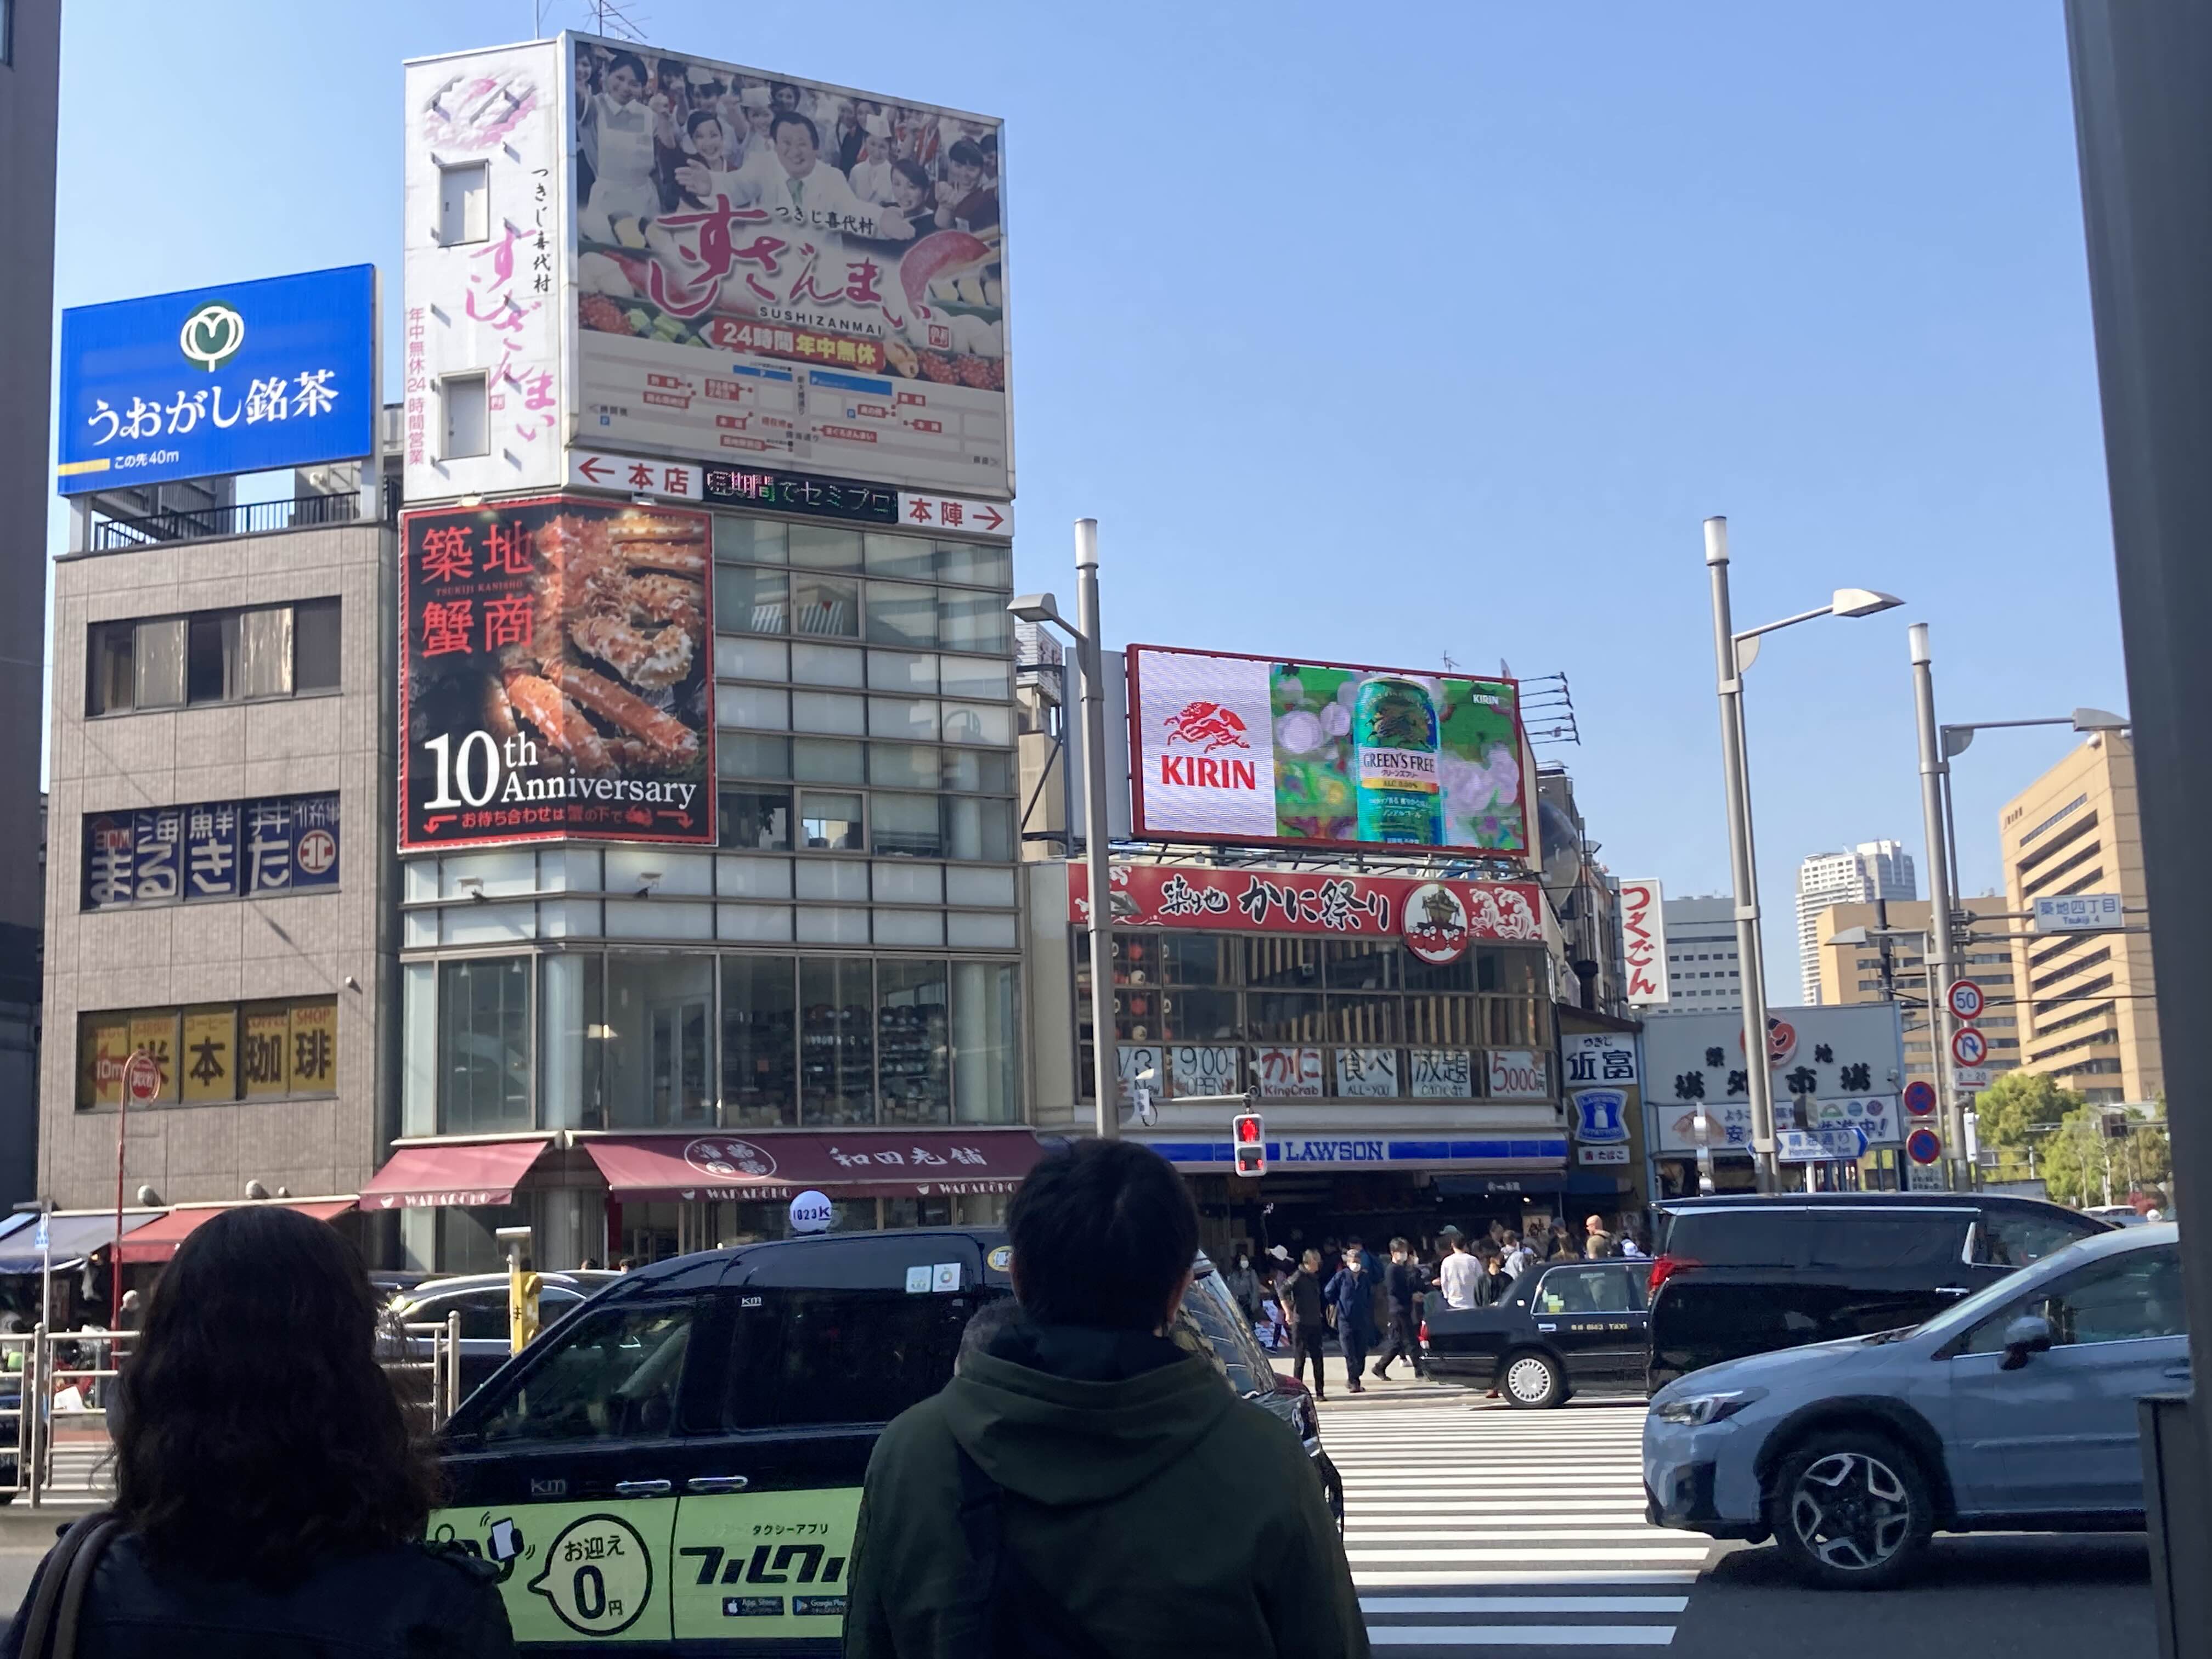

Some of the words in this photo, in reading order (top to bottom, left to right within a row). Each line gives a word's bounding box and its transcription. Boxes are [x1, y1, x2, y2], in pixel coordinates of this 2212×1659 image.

[532, 167, 552, 294] つきじ喜代村
[775, 204, 874, 236] つきじ喜代村
[759, 307, 882, 336] SUSHIZANMAI
[408, 307, 426, 465] 年中無休24時間営業
[87, 369, 338, 446] うおがし銘茶
[115, 450, 179, 469] この先40m
[628, 463, 689, 495] 本店
[910, 498, 963, 528] 本陣
[421, 520, 534, 585] 築地
[421, 594, 534, 658] 蟹商
[1472, 694, 1499, 705] KIRIN
[424, 730, 538, 809] 10th
[1161, 754, 1256, 790] KIRIN
[1363, 752, 1408, 769] GREEN'S
[1410, 756, 1435, 774] FREE
[501, 768, 696, 810] Anniversary
[2040, 899, 2115, 915] 築地四丁目
[1622, 887, 1656, 995] つくごん
[1956, 992, 1976, 1009] 50
[297, 1008, 330, 1026] SHOP
[1584, 1036, 1612, 1047] つきじ
[1262, 1047, 1319, 1084] かに
[1339, 1048, 1393, 1082] 食べ
[1414, 1049, 1468, 1083] 放題
[1566, 1050, 1634, 1080] 近富
[1186, 1077, 1224, 1096] OPEN
[1286, 1142, 1383, 1161] LAWSON
[1598, 1151, 1624, 1160] たばこ
[753, 1523, 828, 1535] タクシーアプリ
[565, 1536, 624, 1561] お迎え
